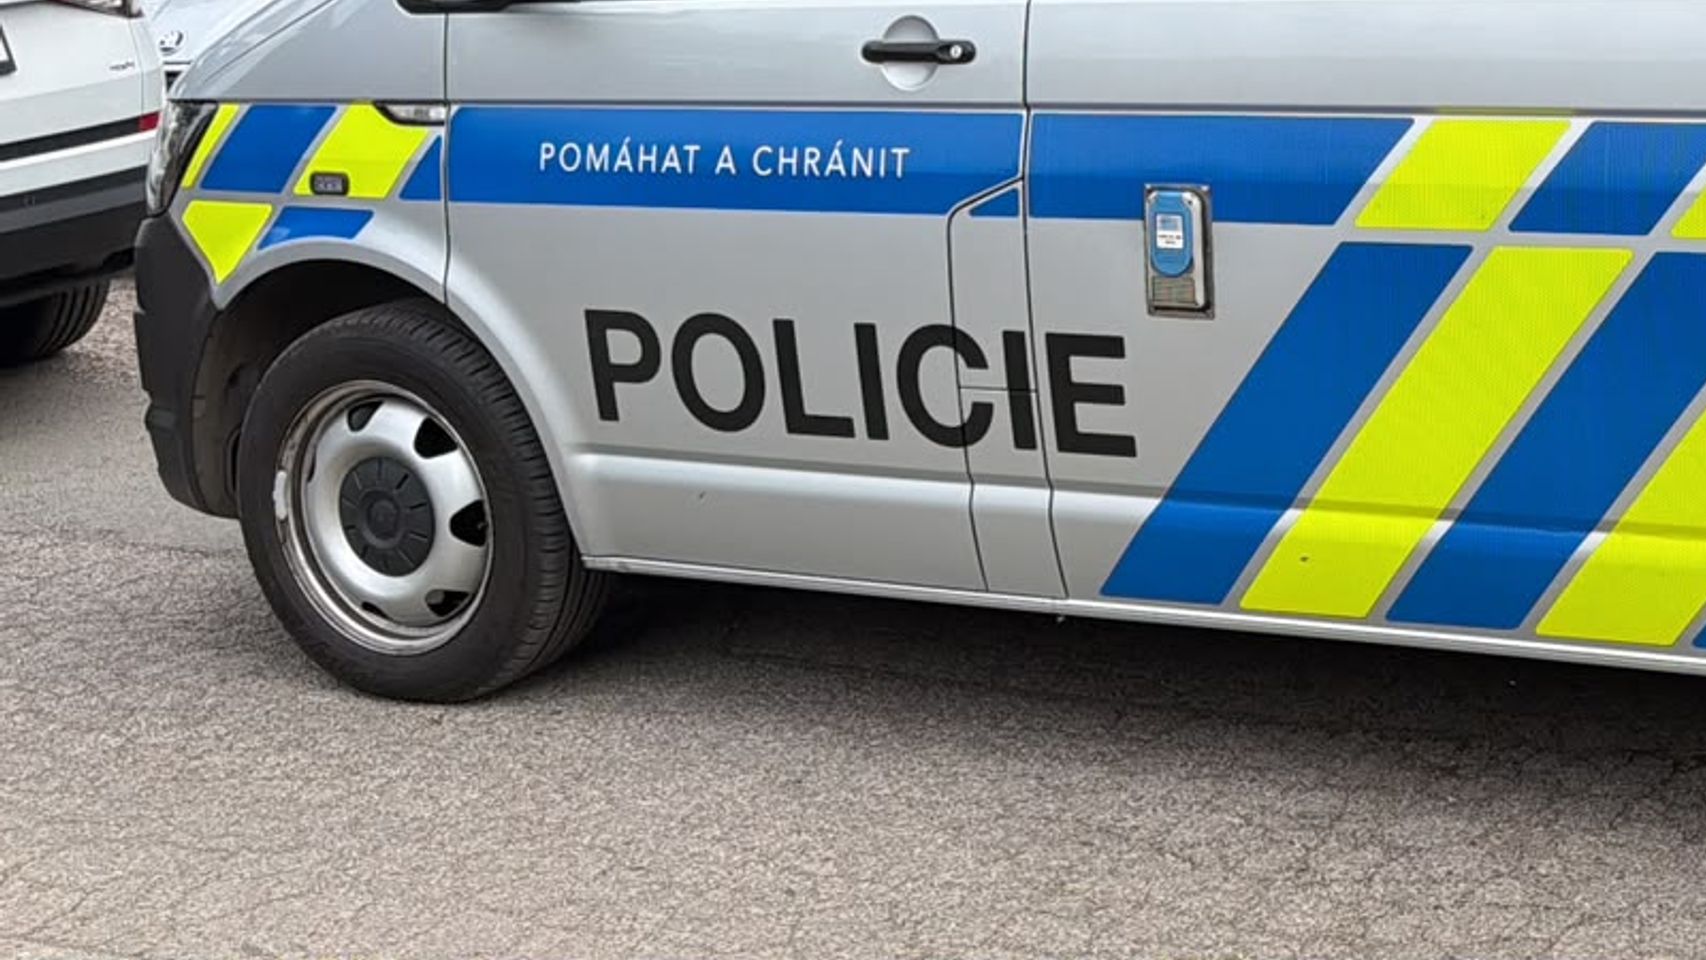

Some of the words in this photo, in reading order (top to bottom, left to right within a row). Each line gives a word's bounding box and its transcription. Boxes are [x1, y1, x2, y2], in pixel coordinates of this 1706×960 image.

[538, 137, 701, 174] POMÁHAT
[715, 145, 737, 176] A
[752, 140, 910, 179] CHRÁNIT
[584, 309, 1137, 458] POLICIE
